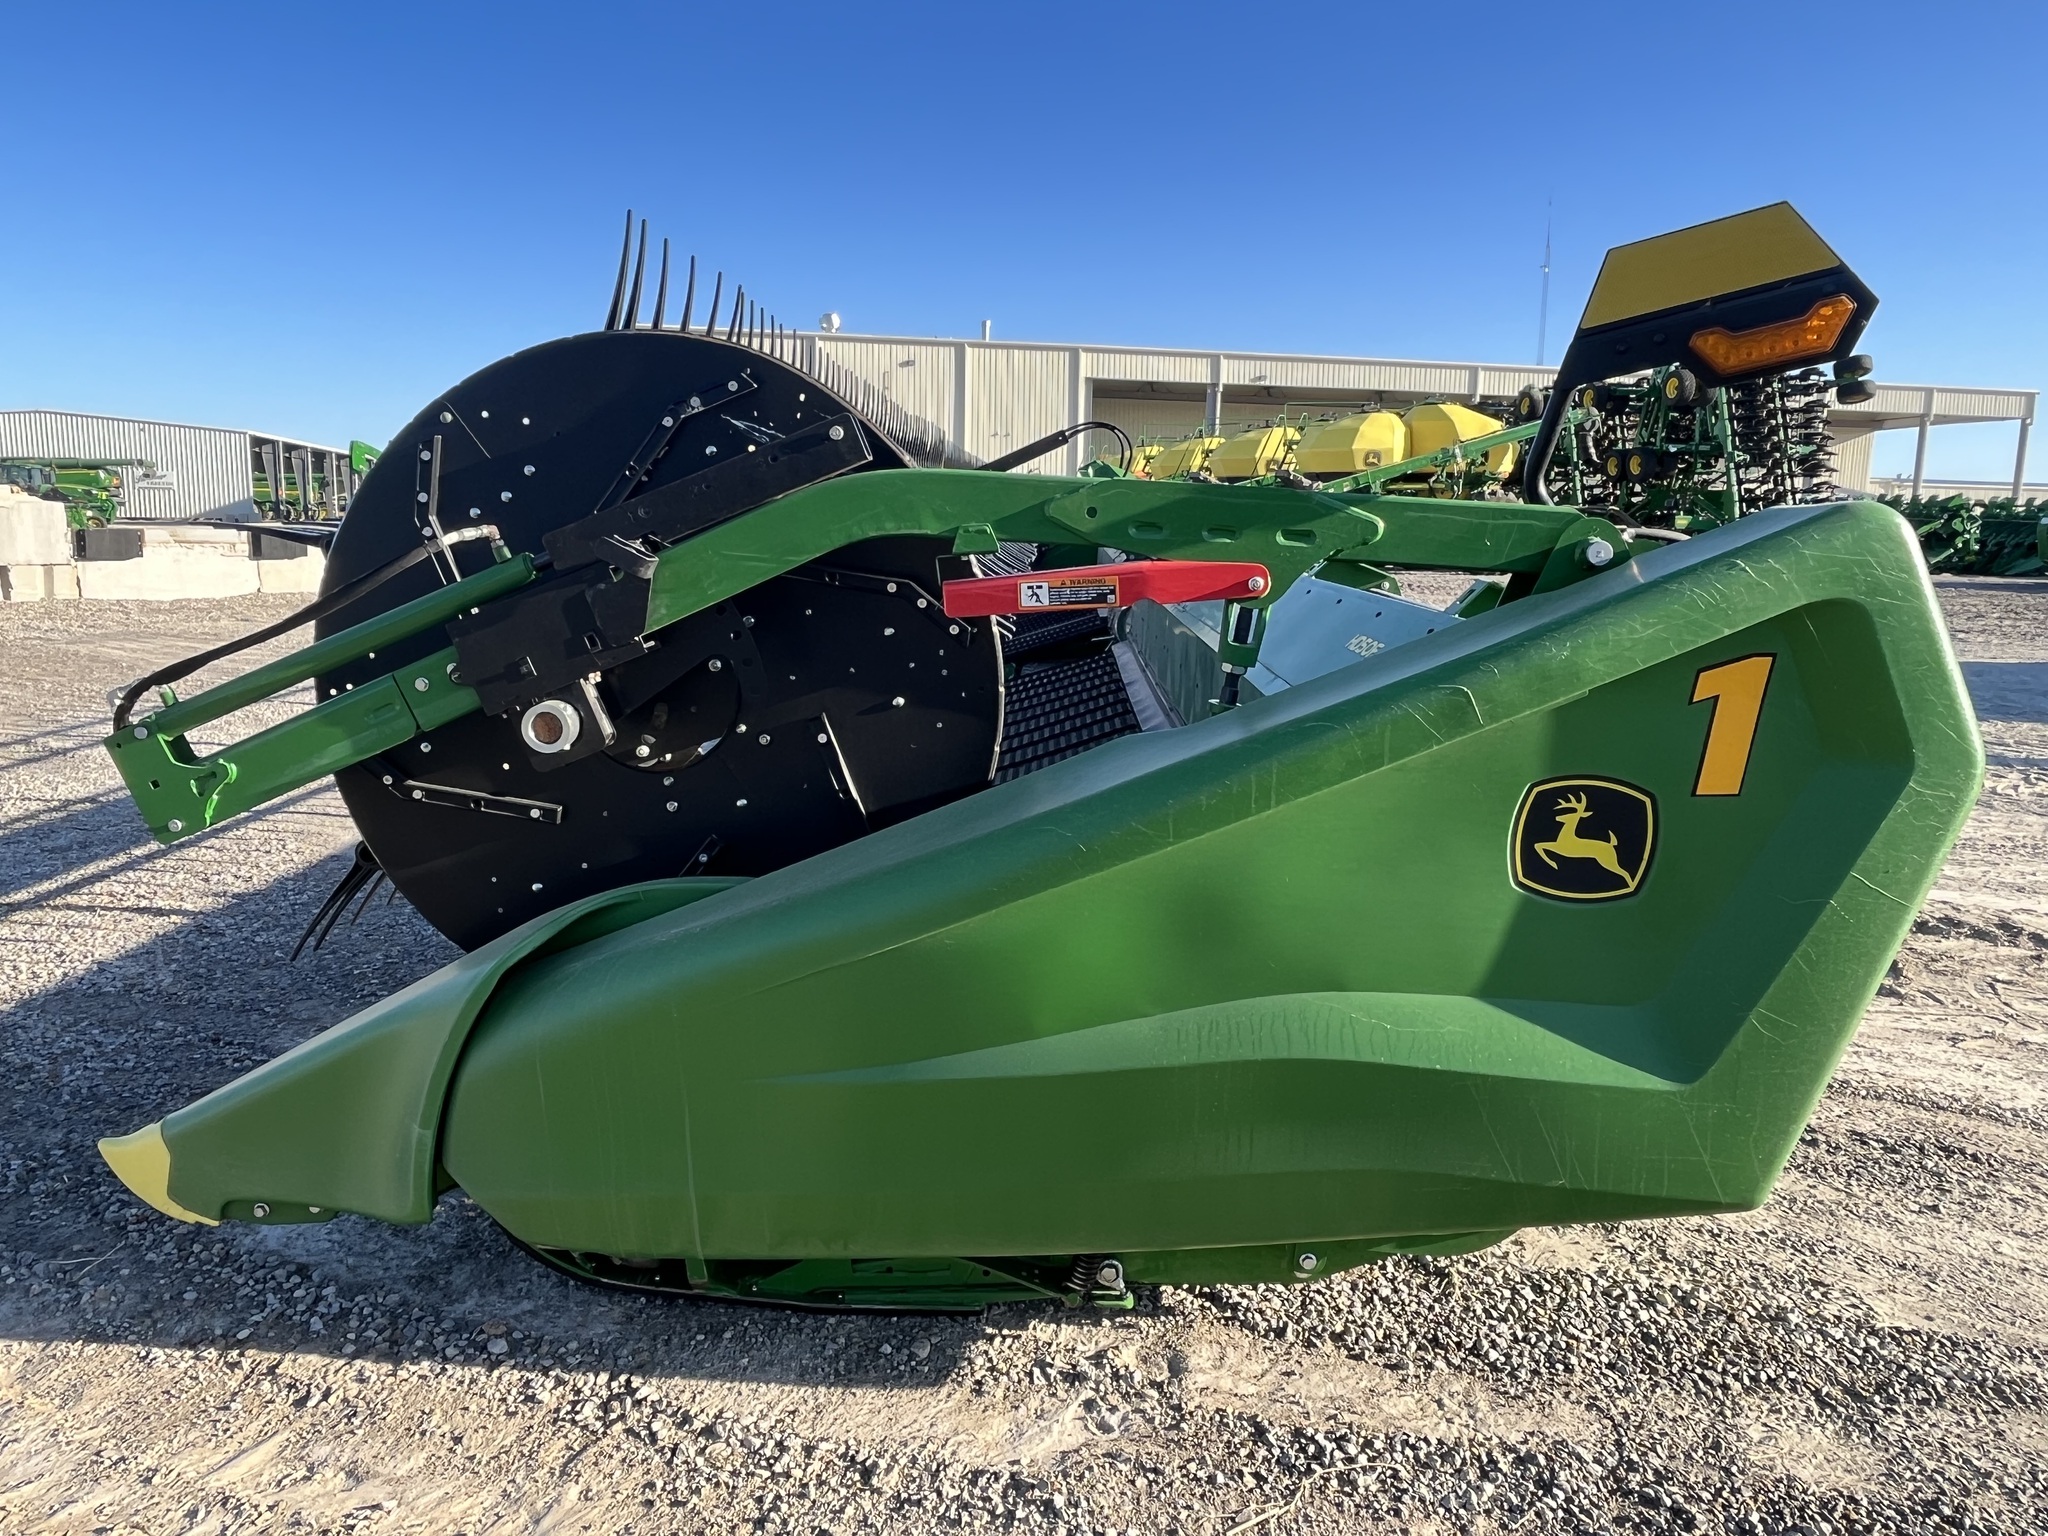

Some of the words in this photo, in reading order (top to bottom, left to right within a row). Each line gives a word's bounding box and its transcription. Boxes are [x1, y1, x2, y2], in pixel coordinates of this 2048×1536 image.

[1069, 578, 1106, 586] WARNING
[1344, 634, 1386, 658] HD50F
[1688, 652, 1777, 797] 1
